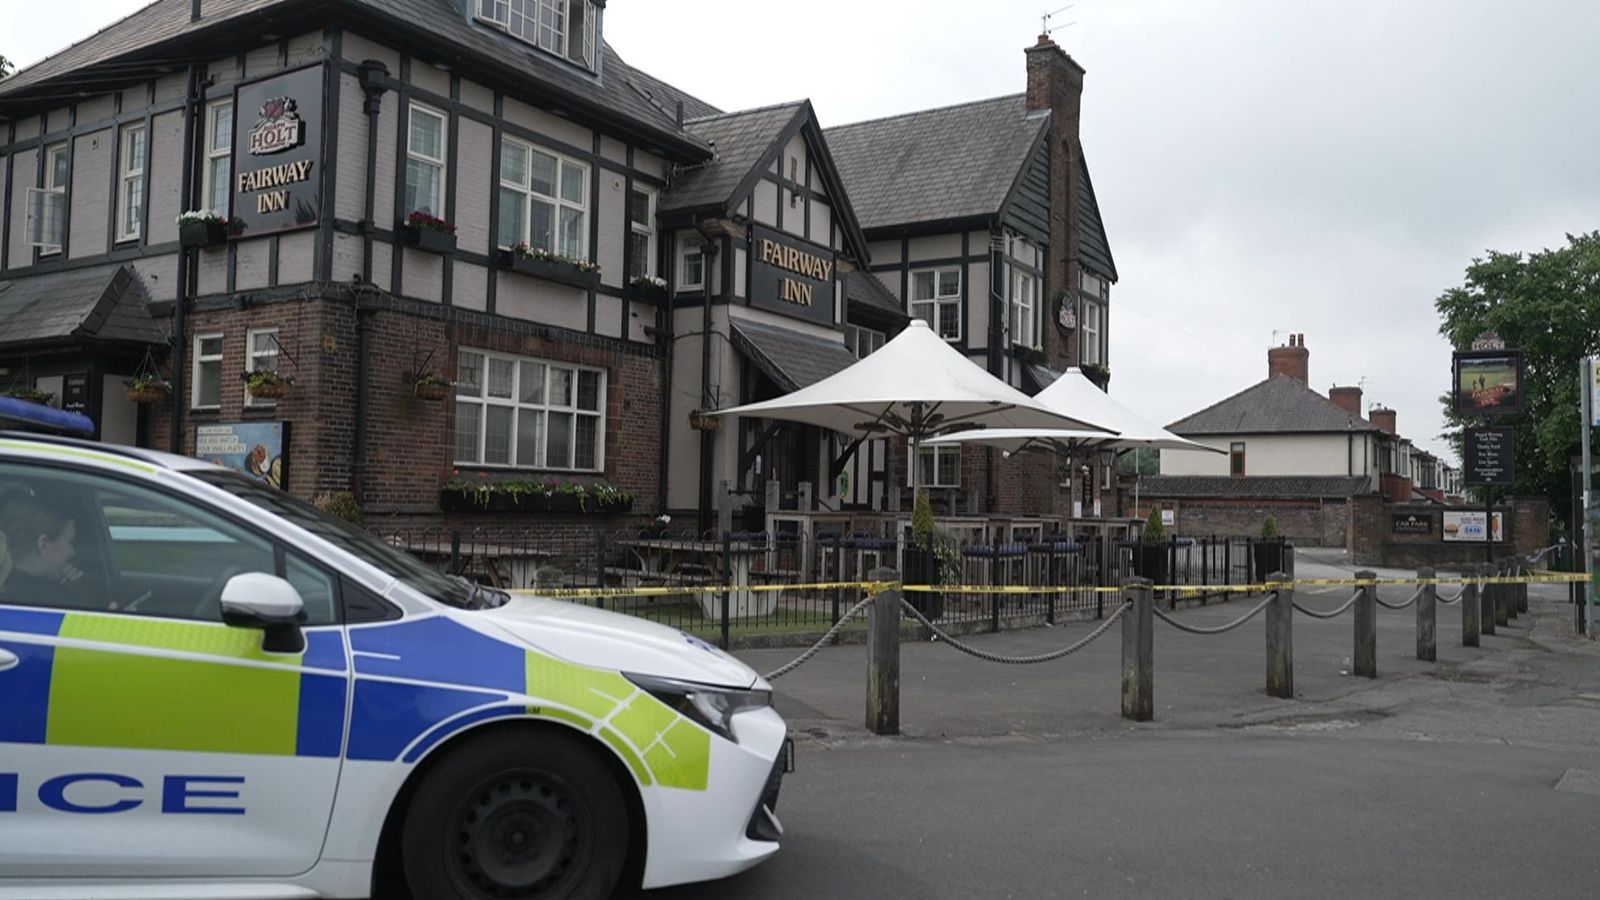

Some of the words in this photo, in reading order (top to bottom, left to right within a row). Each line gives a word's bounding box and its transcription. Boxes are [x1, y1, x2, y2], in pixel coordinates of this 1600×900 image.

[251, 125, 297, 149] HOLT
[238, 159, 311, 193] FAIRWAY
[257, 189, 288, 214] INN
[762, 238, 833, 281] FAIRWAY
[783, 277, 813, 307] INN
[0, 773, 246, 815] ICE
